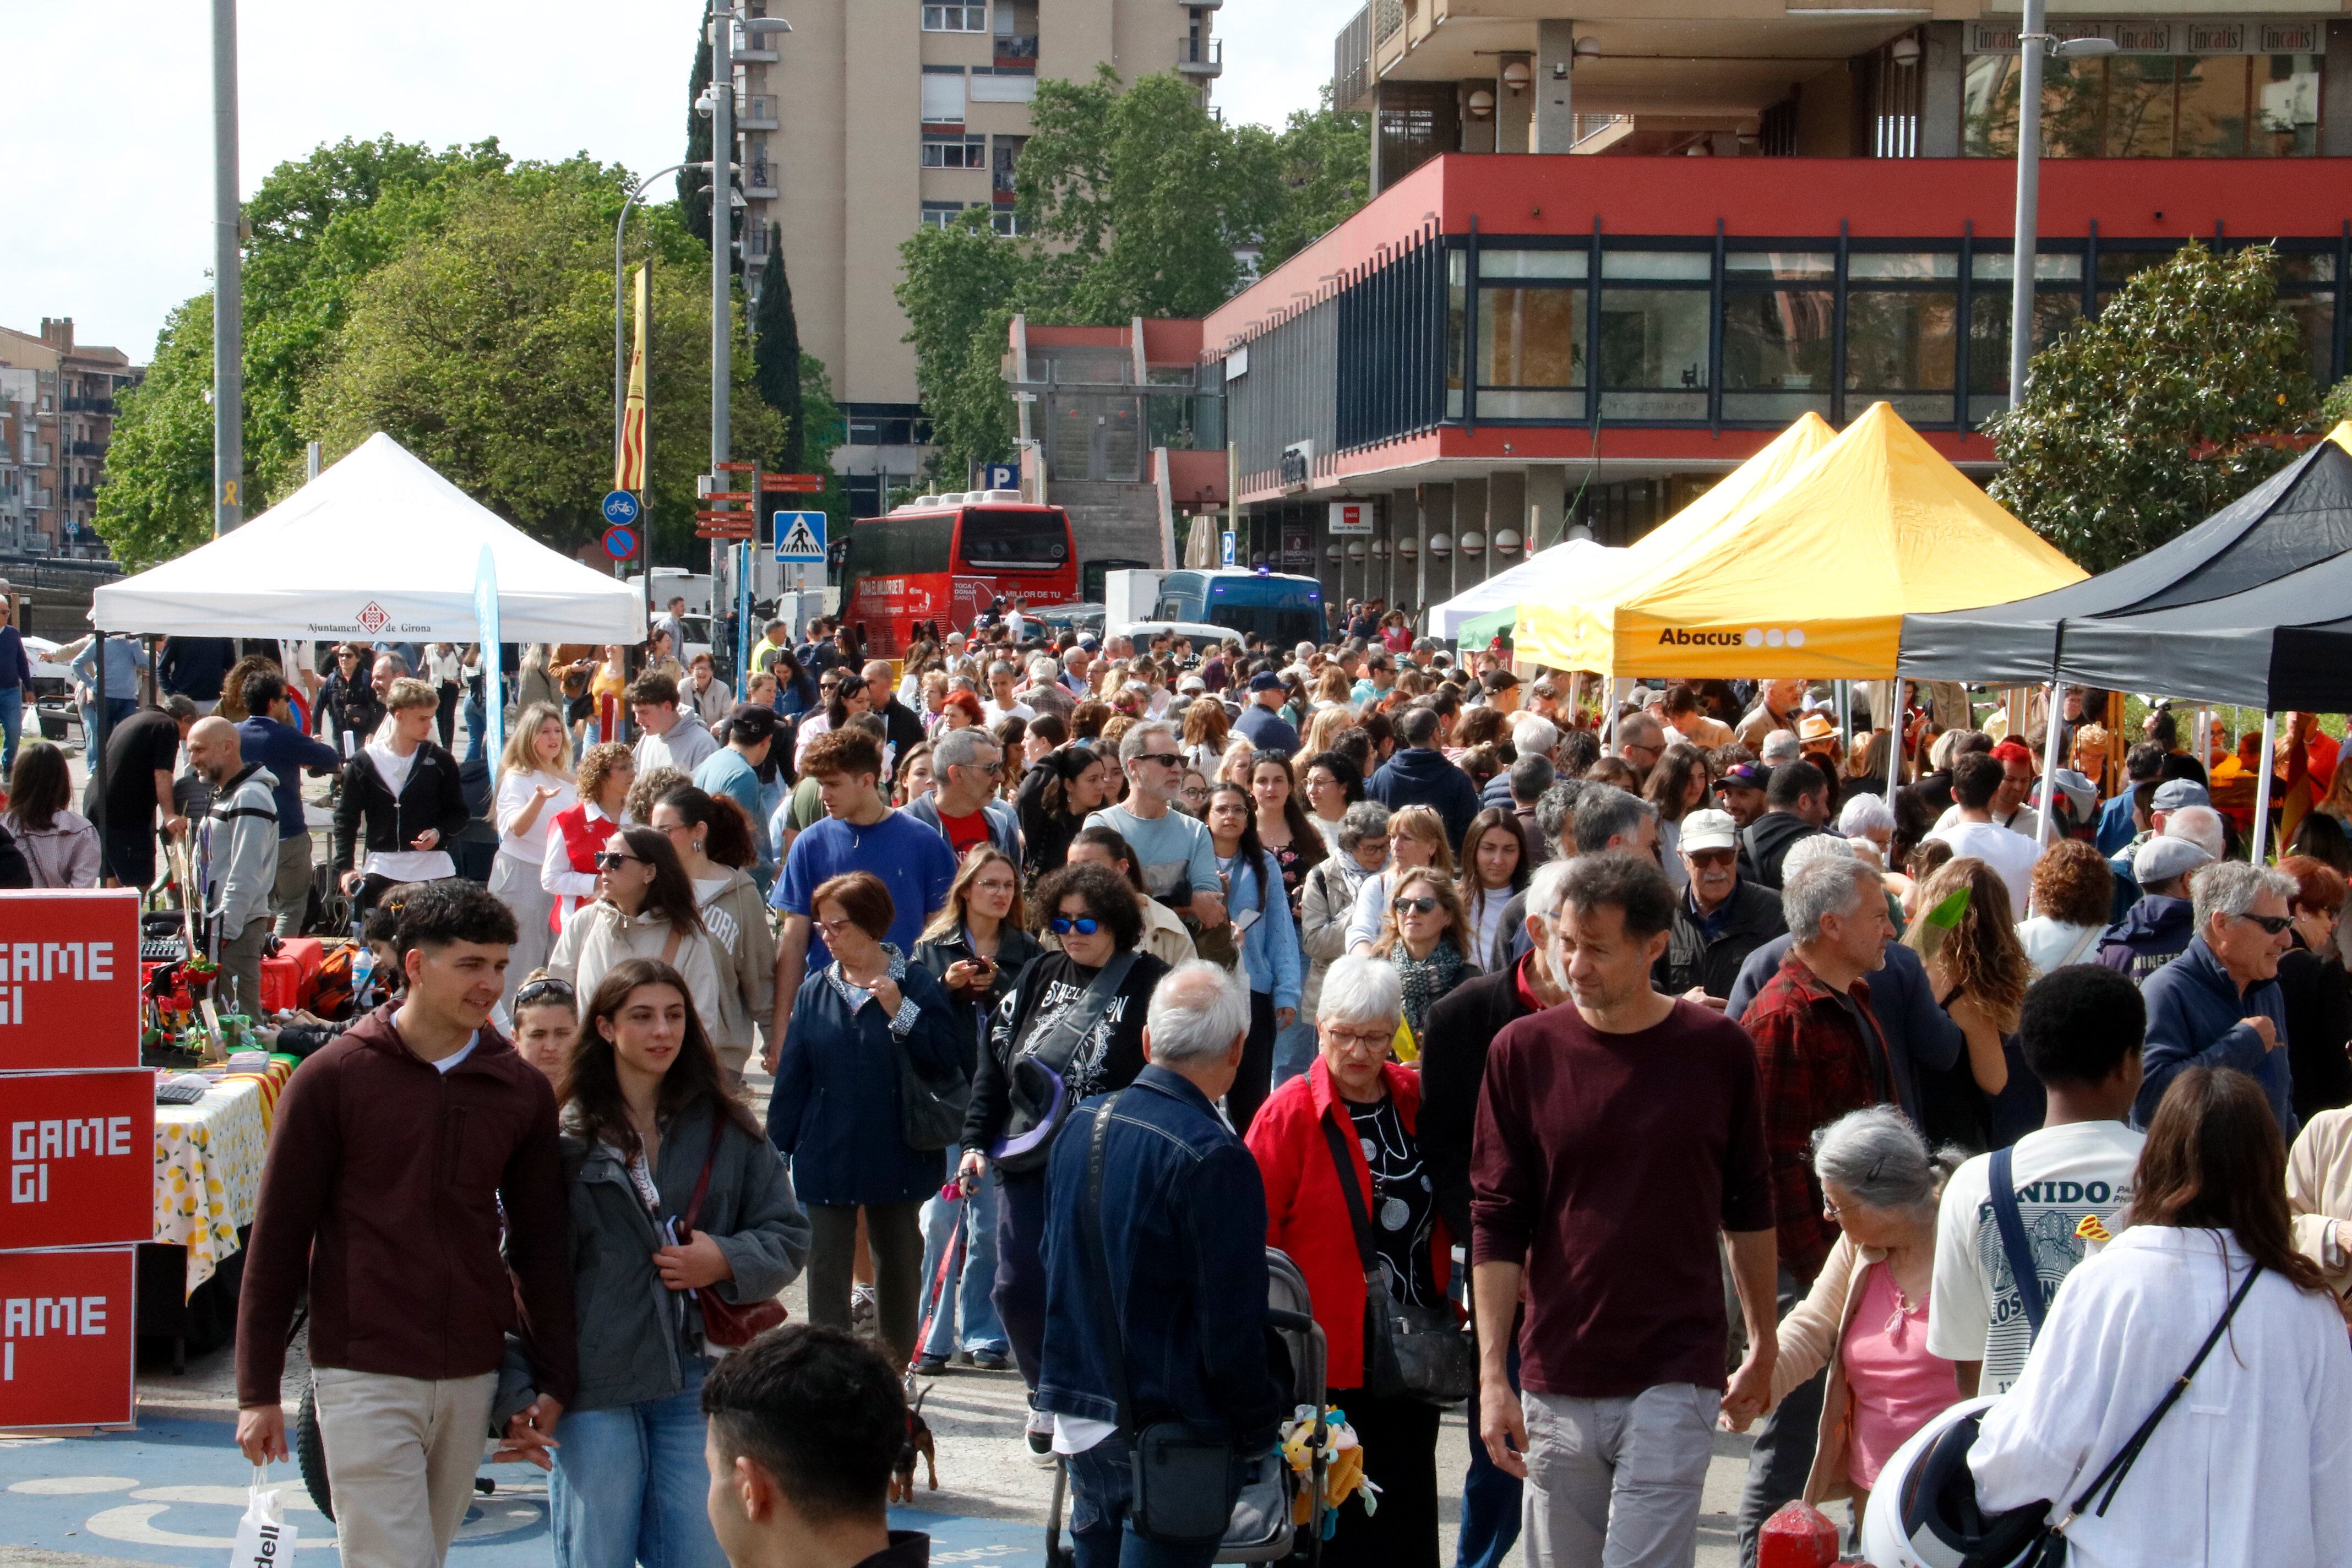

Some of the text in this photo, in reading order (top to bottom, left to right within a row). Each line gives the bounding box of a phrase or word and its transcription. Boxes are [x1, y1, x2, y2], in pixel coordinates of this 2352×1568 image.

[994, 468, 1010, 488] P
[1224, 536, 1232, 561] P
[307, 623, 431, 633] Ajuntament de Girona
[1658, 628, 1741, 645] Abacus
[12, 1117, 131, 1161] GAME
[12, 1163, 48, 1204] GI
[0, 1297, 106, 1337] AME
